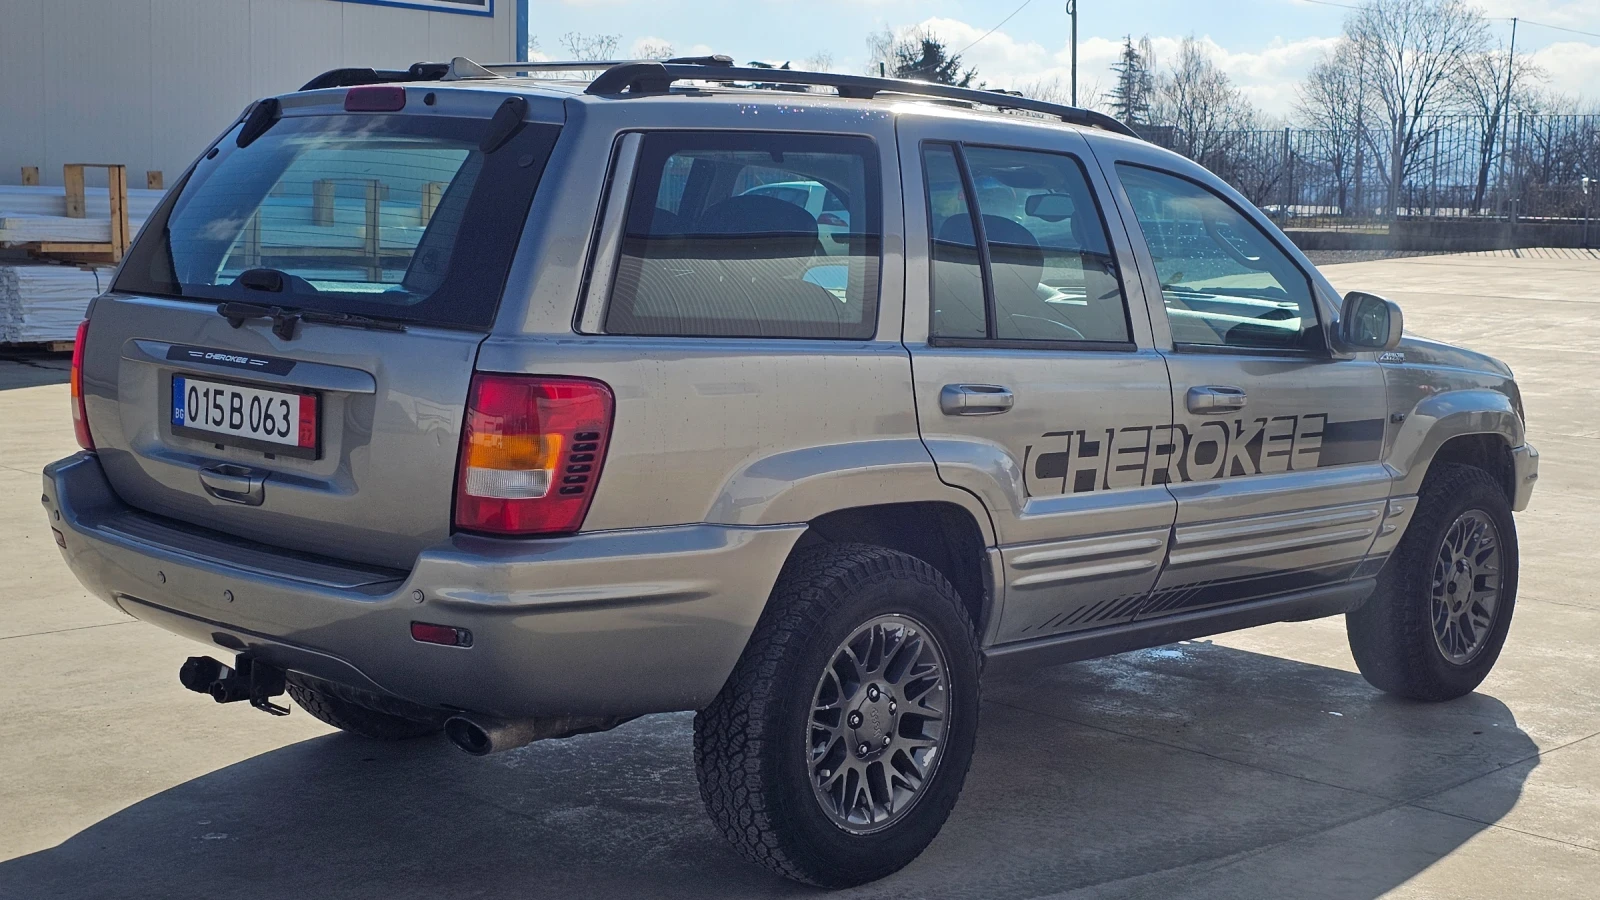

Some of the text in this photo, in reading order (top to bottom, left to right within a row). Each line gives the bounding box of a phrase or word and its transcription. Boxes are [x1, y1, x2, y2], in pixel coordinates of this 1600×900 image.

[204, 352, 249, 364] CHEROKEE
[175, 407, 185, 420] BG
[1024, 413, 1329, 497] CHEROKEE
